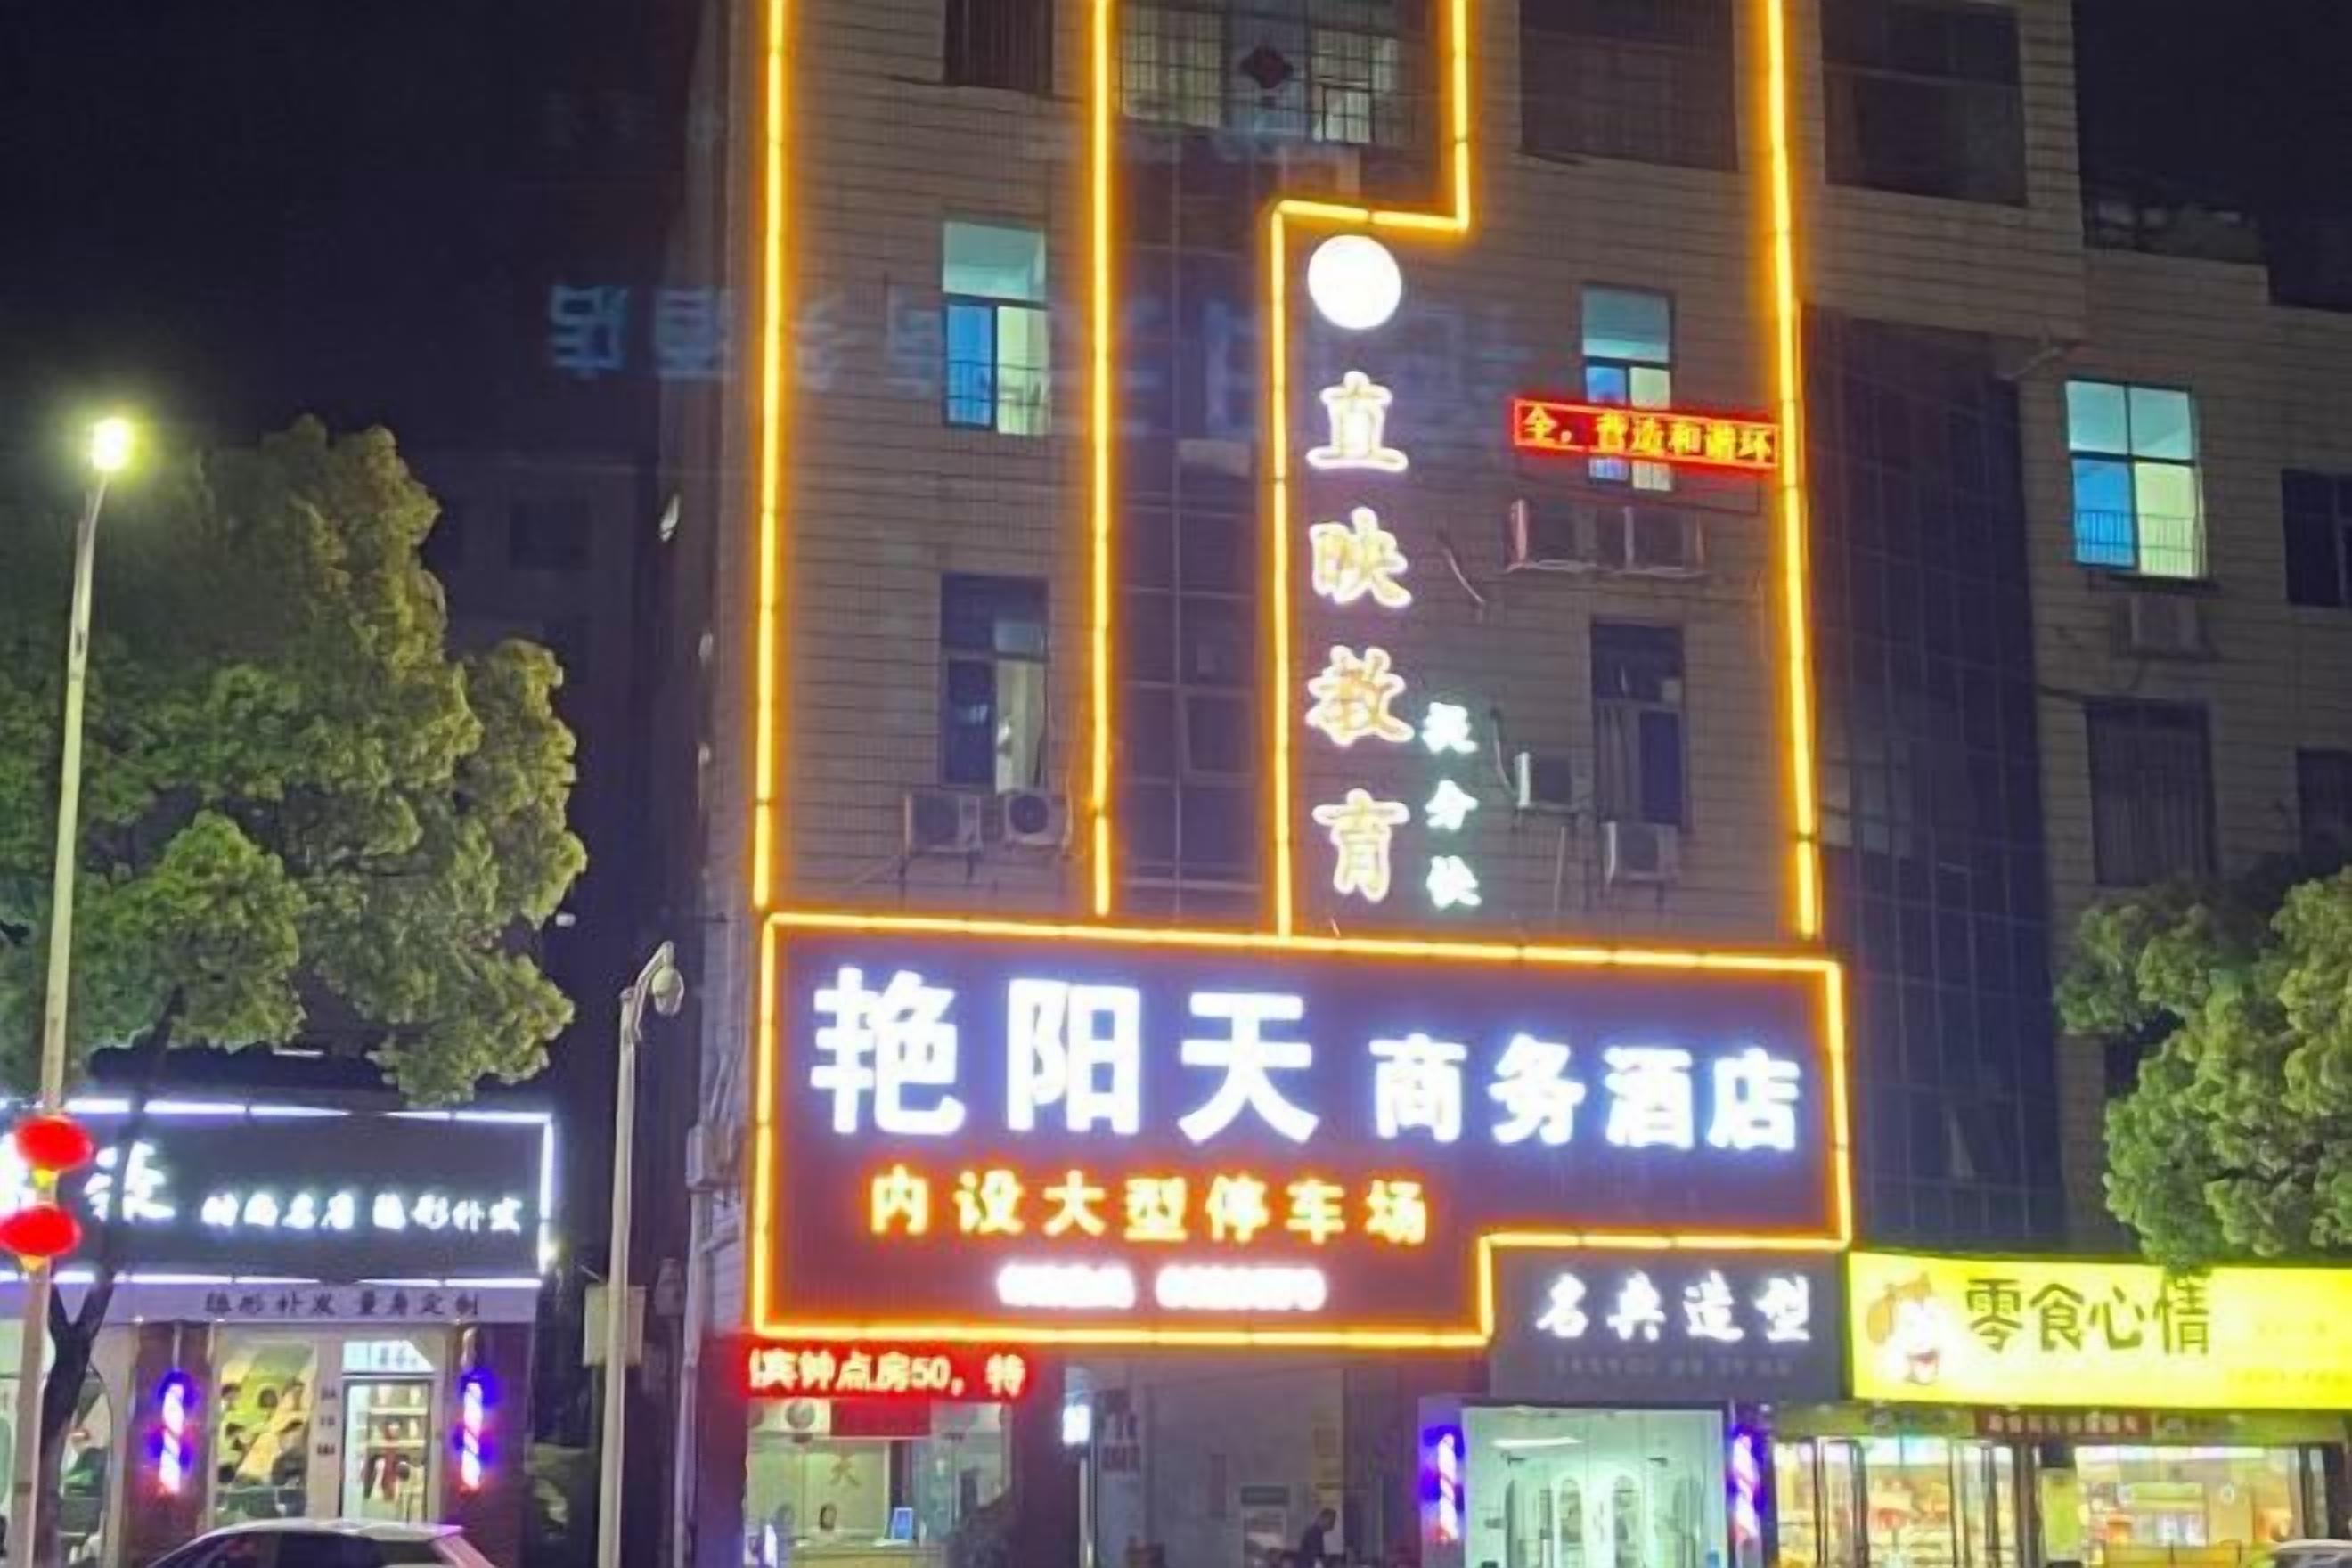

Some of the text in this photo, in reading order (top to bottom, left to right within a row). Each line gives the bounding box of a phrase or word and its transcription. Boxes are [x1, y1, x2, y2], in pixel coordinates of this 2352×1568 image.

[810, 966, 1801, 1152] 艳阳天 商务酒店
[870, 1164, 1428, 1245] 内设大型停车场
[1964, 1274, 2212, 1356] 零食心情
